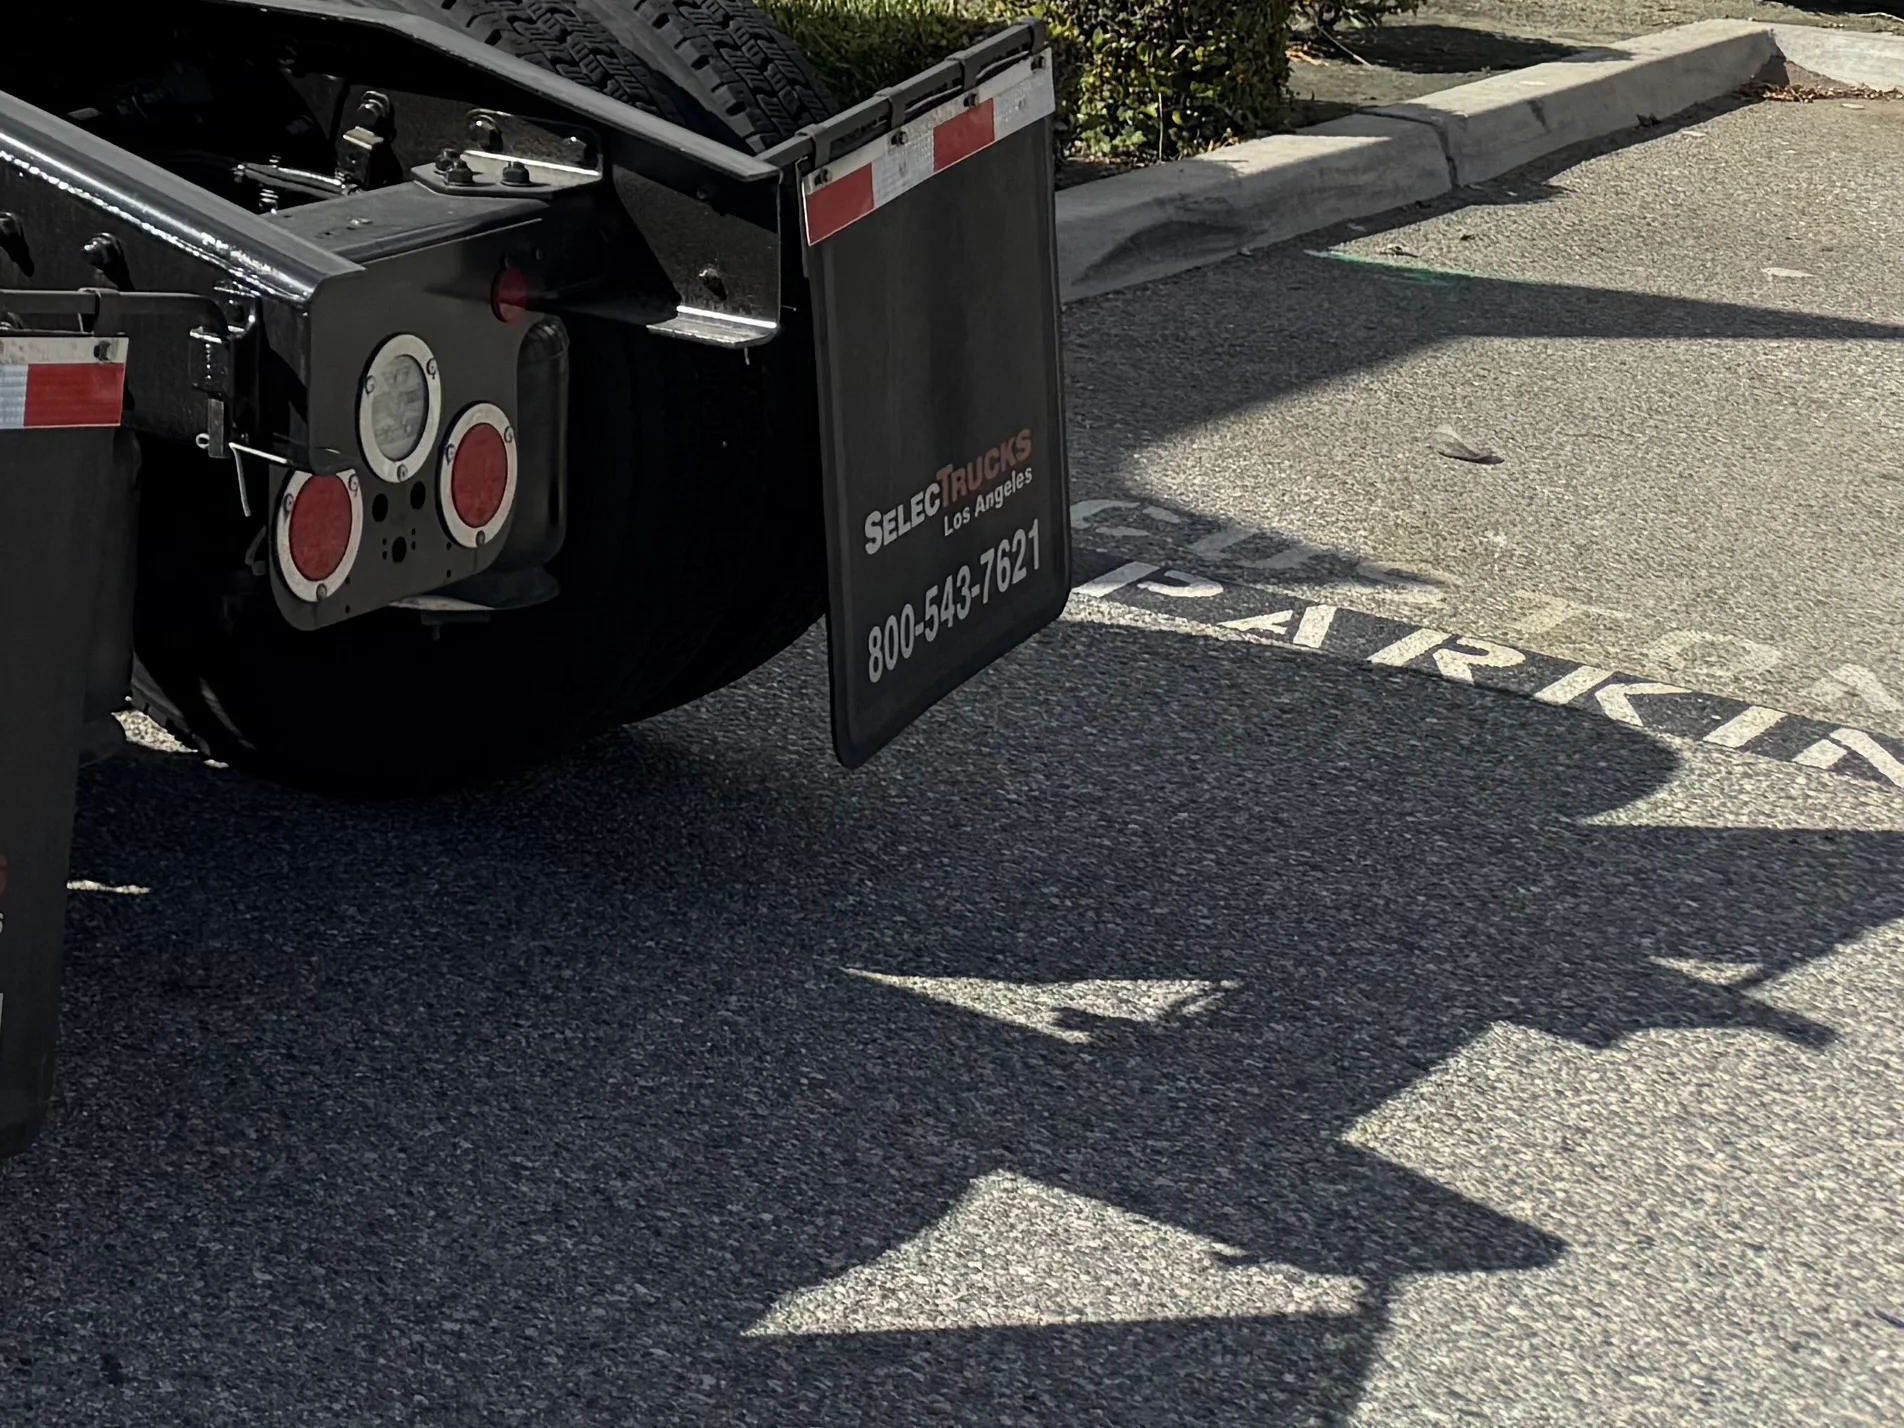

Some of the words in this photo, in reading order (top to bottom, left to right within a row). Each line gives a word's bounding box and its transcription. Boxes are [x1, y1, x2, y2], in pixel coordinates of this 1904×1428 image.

[943, 508, 971, 537] Los
[975, 466, 1033, 515] Angeles
[867, 518, 1040, 684] 800-543-7621
